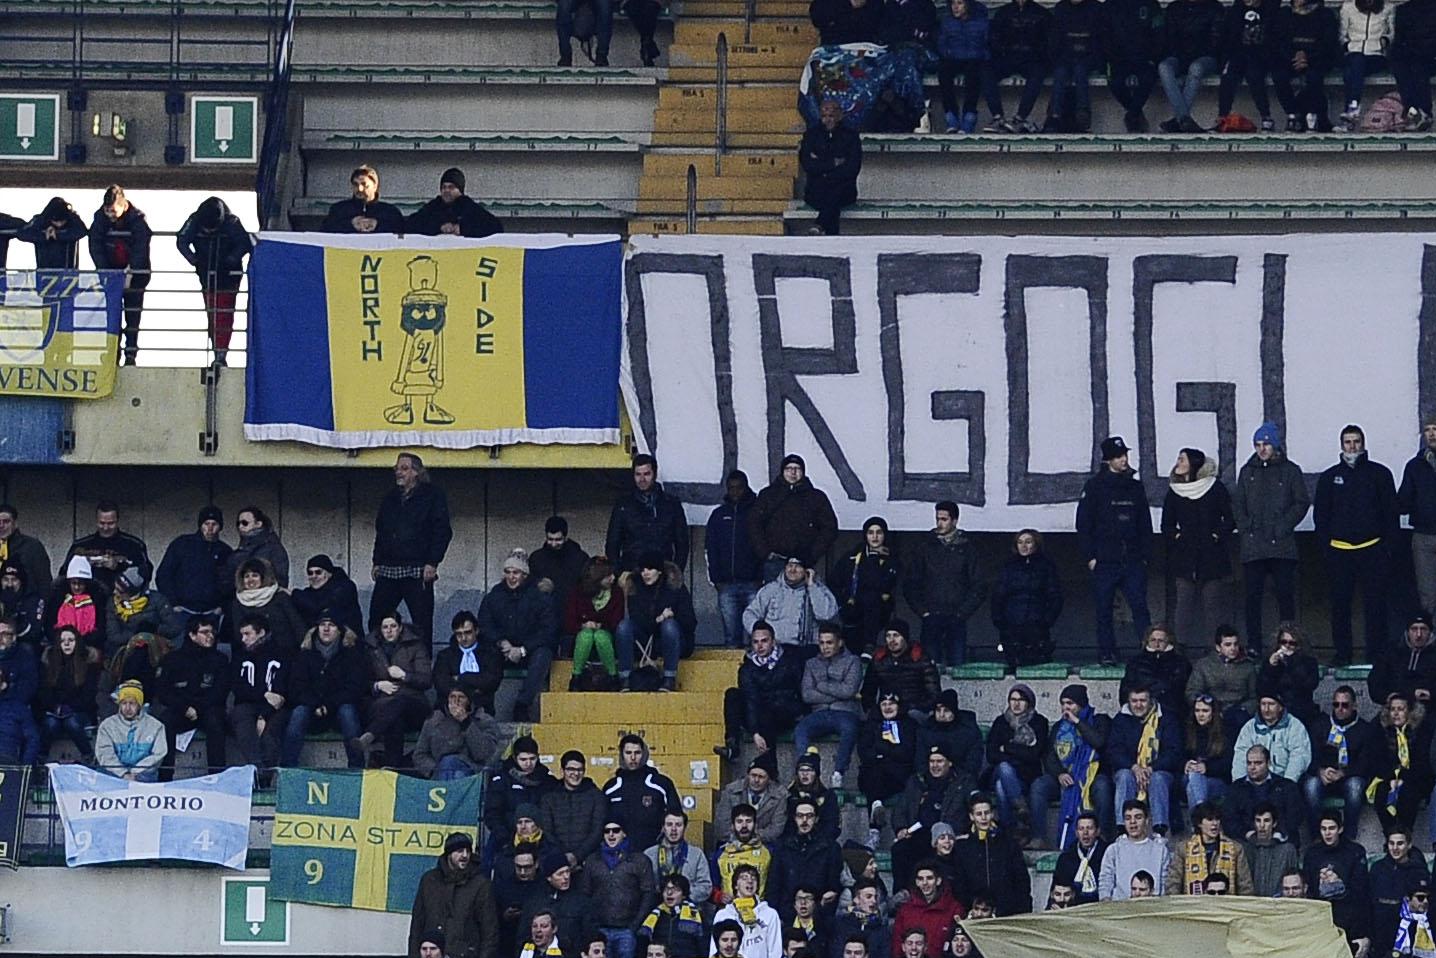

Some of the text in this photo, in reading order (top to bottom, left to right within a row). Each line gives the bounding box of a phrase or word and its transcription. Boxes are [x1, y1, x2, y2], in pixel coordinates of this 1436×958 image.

[360, 254, 383, 362] NORTH
[475, 256, 499, 355] SIDE
[79, 794, 204, 812] MONTORIO
[306, 780, 449, 812] N S
[193, 829, 215, 851] 4
[276, 820, 475, 849] ZONA STAD
[303, 858, 324, 886] 9
